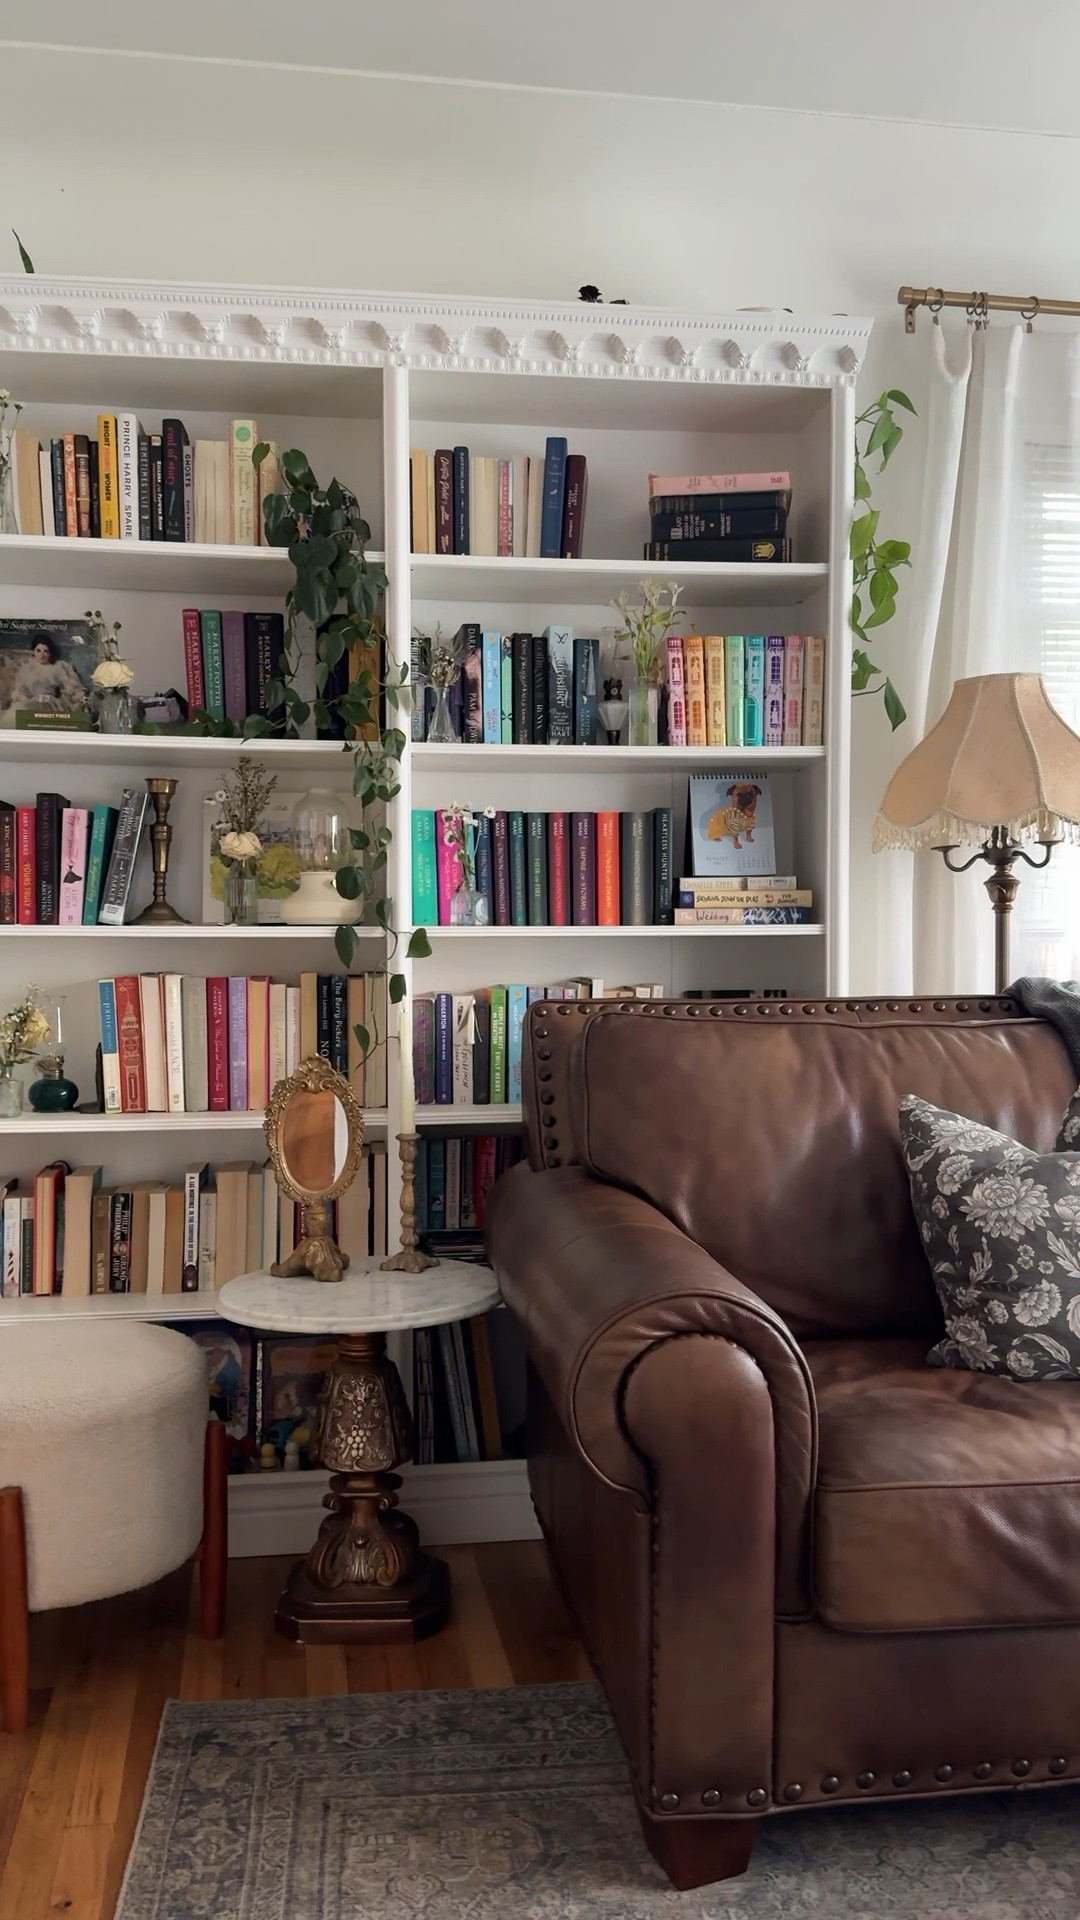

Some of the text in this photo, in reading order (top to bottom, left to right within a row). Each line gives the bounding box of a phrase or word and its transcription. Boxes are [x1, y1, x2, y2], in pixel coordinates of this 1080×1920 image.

[140, 442, 148, 487] SOMETIMES
[165, 426, 178, 486] end of story
[191, 631, 200, 668] HARRY
[212, 632, 220, 668] HARRY
[125, 816, 134, 837] MOON
[109, 875, 118, 902] PARKER
[117, 873, 126, 898] SARAH
[680, 911, 693, 920] The
[696, 910, 729, 923] Wedding
[103, 1003, 113, 1029] panic
[334, 997, 342, 1019] Berry
